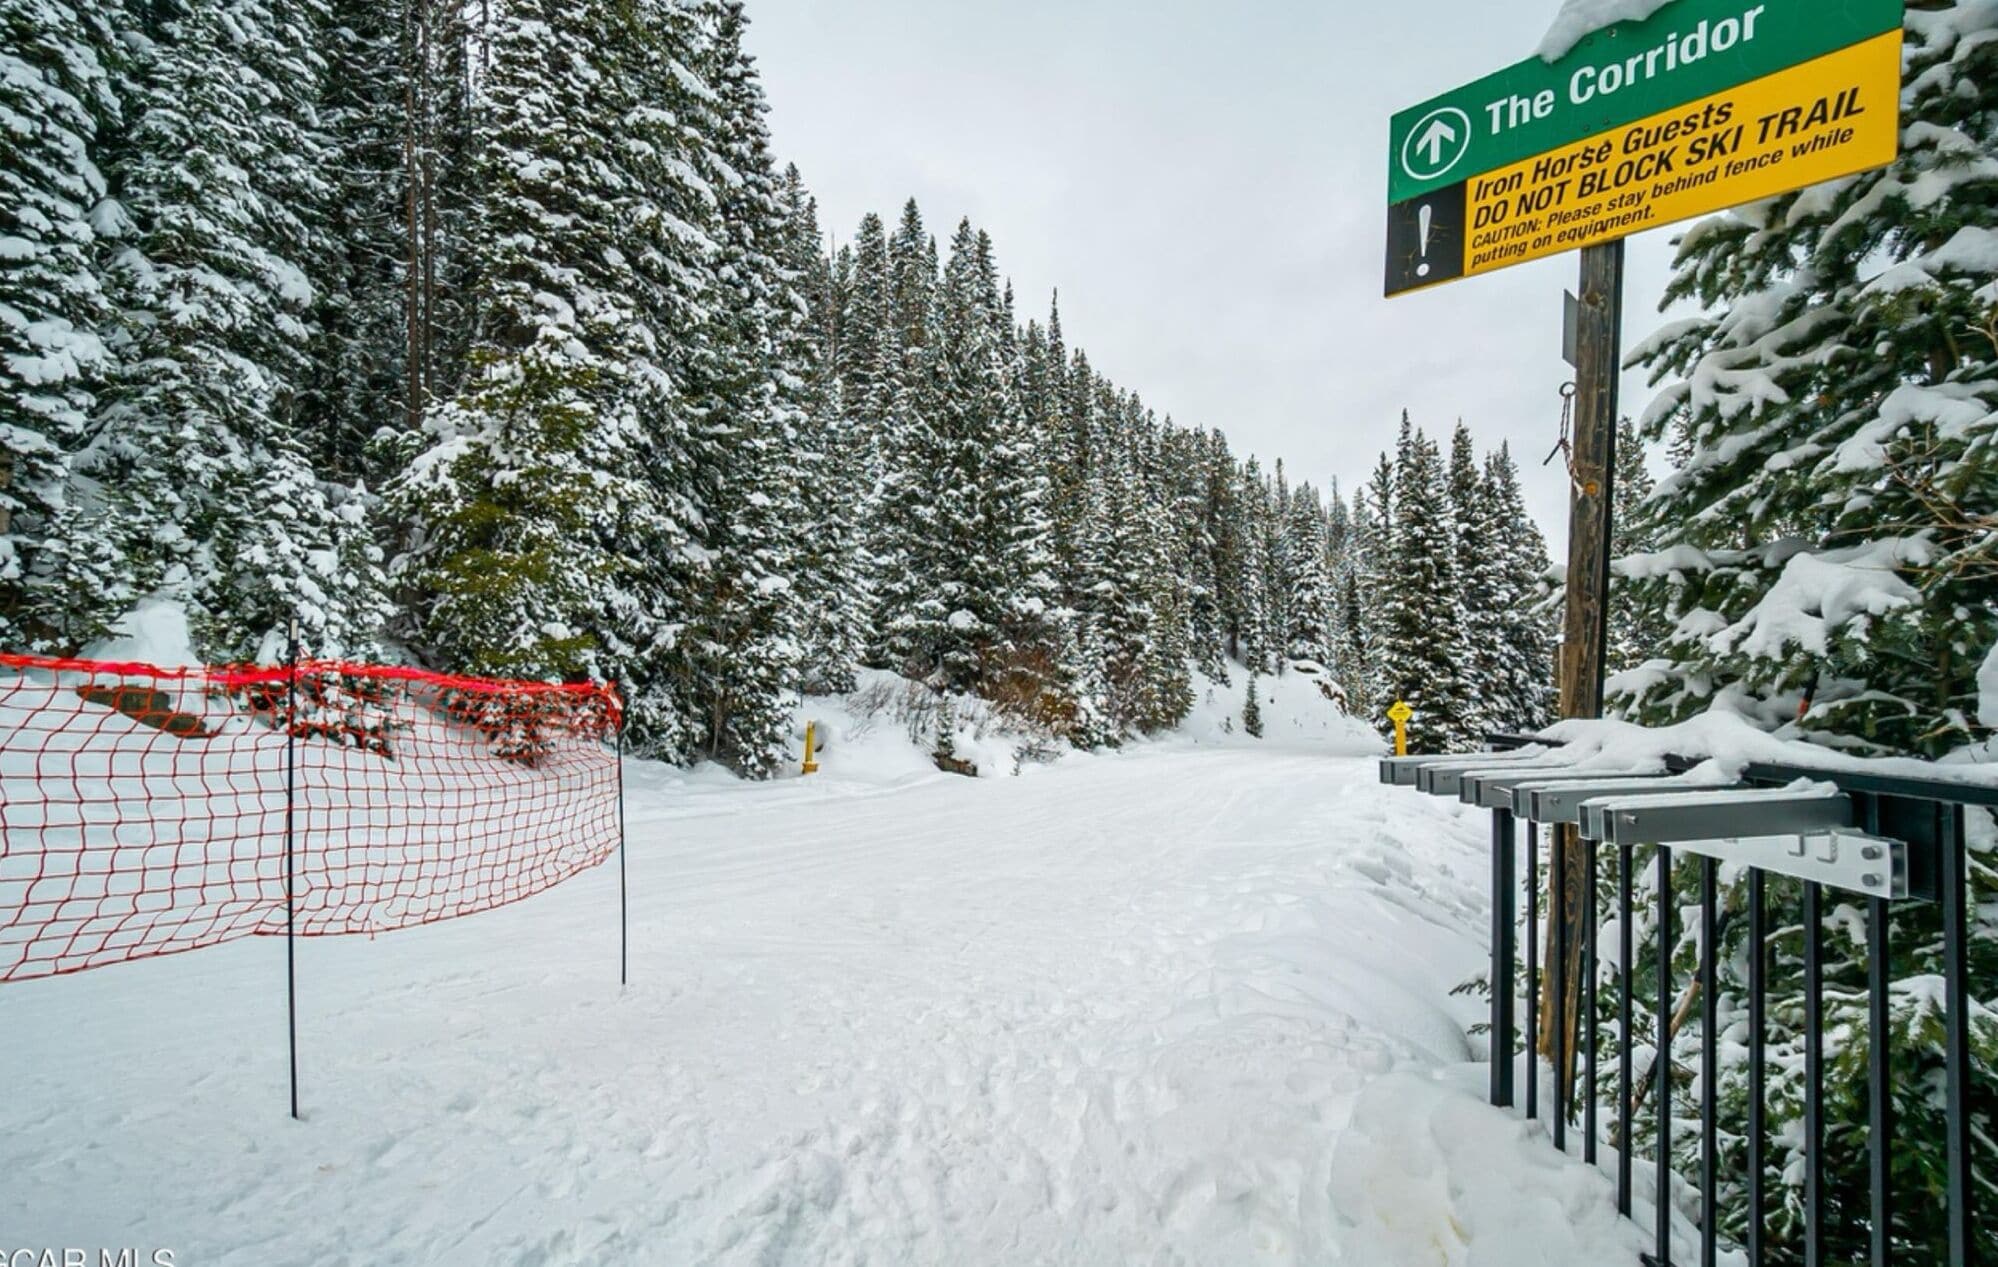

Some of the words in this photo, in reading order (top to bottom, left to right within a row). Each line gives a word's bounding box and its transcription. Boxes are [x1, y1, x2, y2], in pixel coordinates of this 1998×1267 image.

[1485, 89, 1555, 135] The
[1569, 5, 1764, 105] Corridor
[1471, 218, 1543, 250] CAUTION:
[1546, 199, 1602, 229] Please
[1606, 188, 1647, 212] stay
[1651, 166, 1718, 199] behind
[1724, 149, 1784, 178] fence
[1791, 127, 1855, 159] while
[1473, 201, 1509, 230] DO
[1515, 178, 1572, 218] NOT
[1576, 145, 1680, 200] BLOCK
[1684, 124, 1743, 167] SKI
[1757, 86, 1865, 145] TRAIL
[1474, 171, 1523, 202] Iron
[1530, 139, 1613, 185] Horse
[1622, 101, 1734, 153] Guests
[1471, 240, 1528, 269] putting
[1532, 235, 1552, 250] on
[1556, 205, 1656, 243] equipment.
